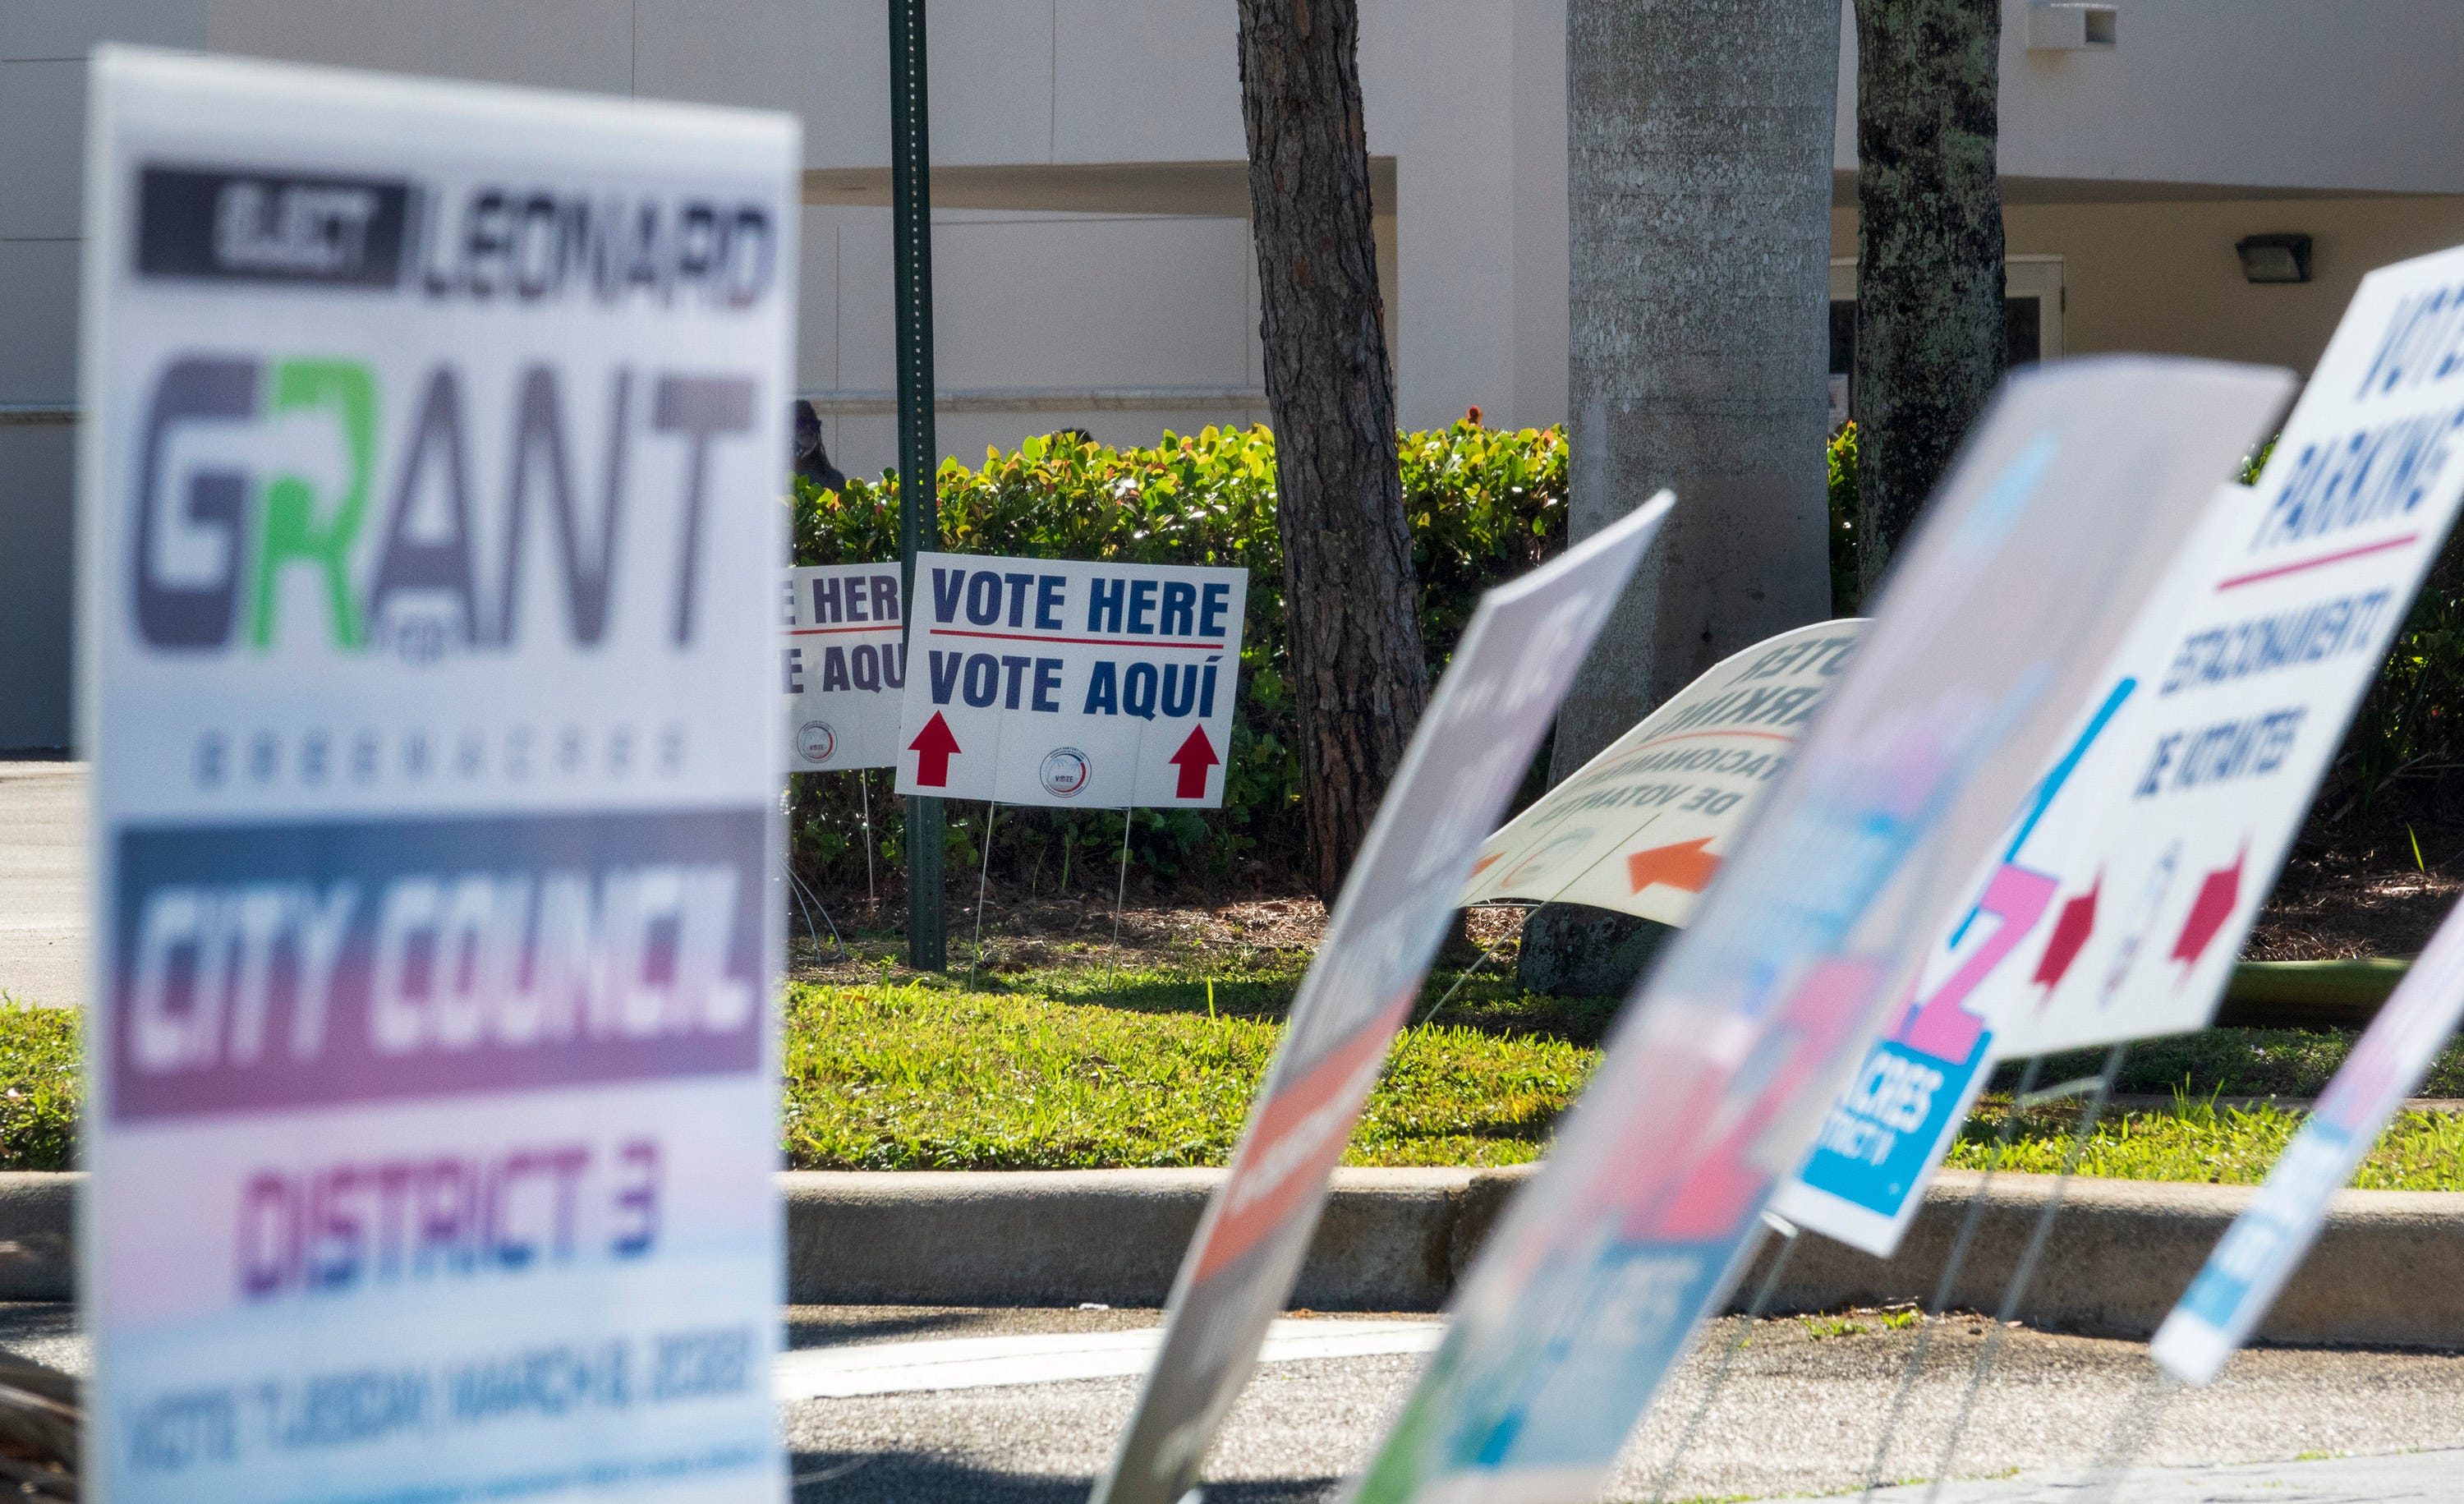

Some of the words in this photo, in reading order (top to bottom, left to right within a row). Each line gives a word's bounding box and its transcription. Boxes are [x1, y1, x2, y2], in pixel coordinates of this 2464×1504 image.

[419, 186, 775, 309] LEONARD
[2355, 284, 2464, 401] VOTE
[131, 353, 760, 652] GRANT
[812, 575, 900, 624] HER
[931, 568, 1068, 630] VOTE
[1087, 577, 1230, 637] HERE
[822, 643, 904, 694] AQU
[929, 651, 1064, 713] VOTE
[1083, 655, 1224, 721] AQUÍ
[131, 881, 358, 1073] CITY
[368, 862, 754, 1051] COUNCIL
[237, 1147, 591, 1304] DISTRICT
[610, 1134, 665, 1259] 3
